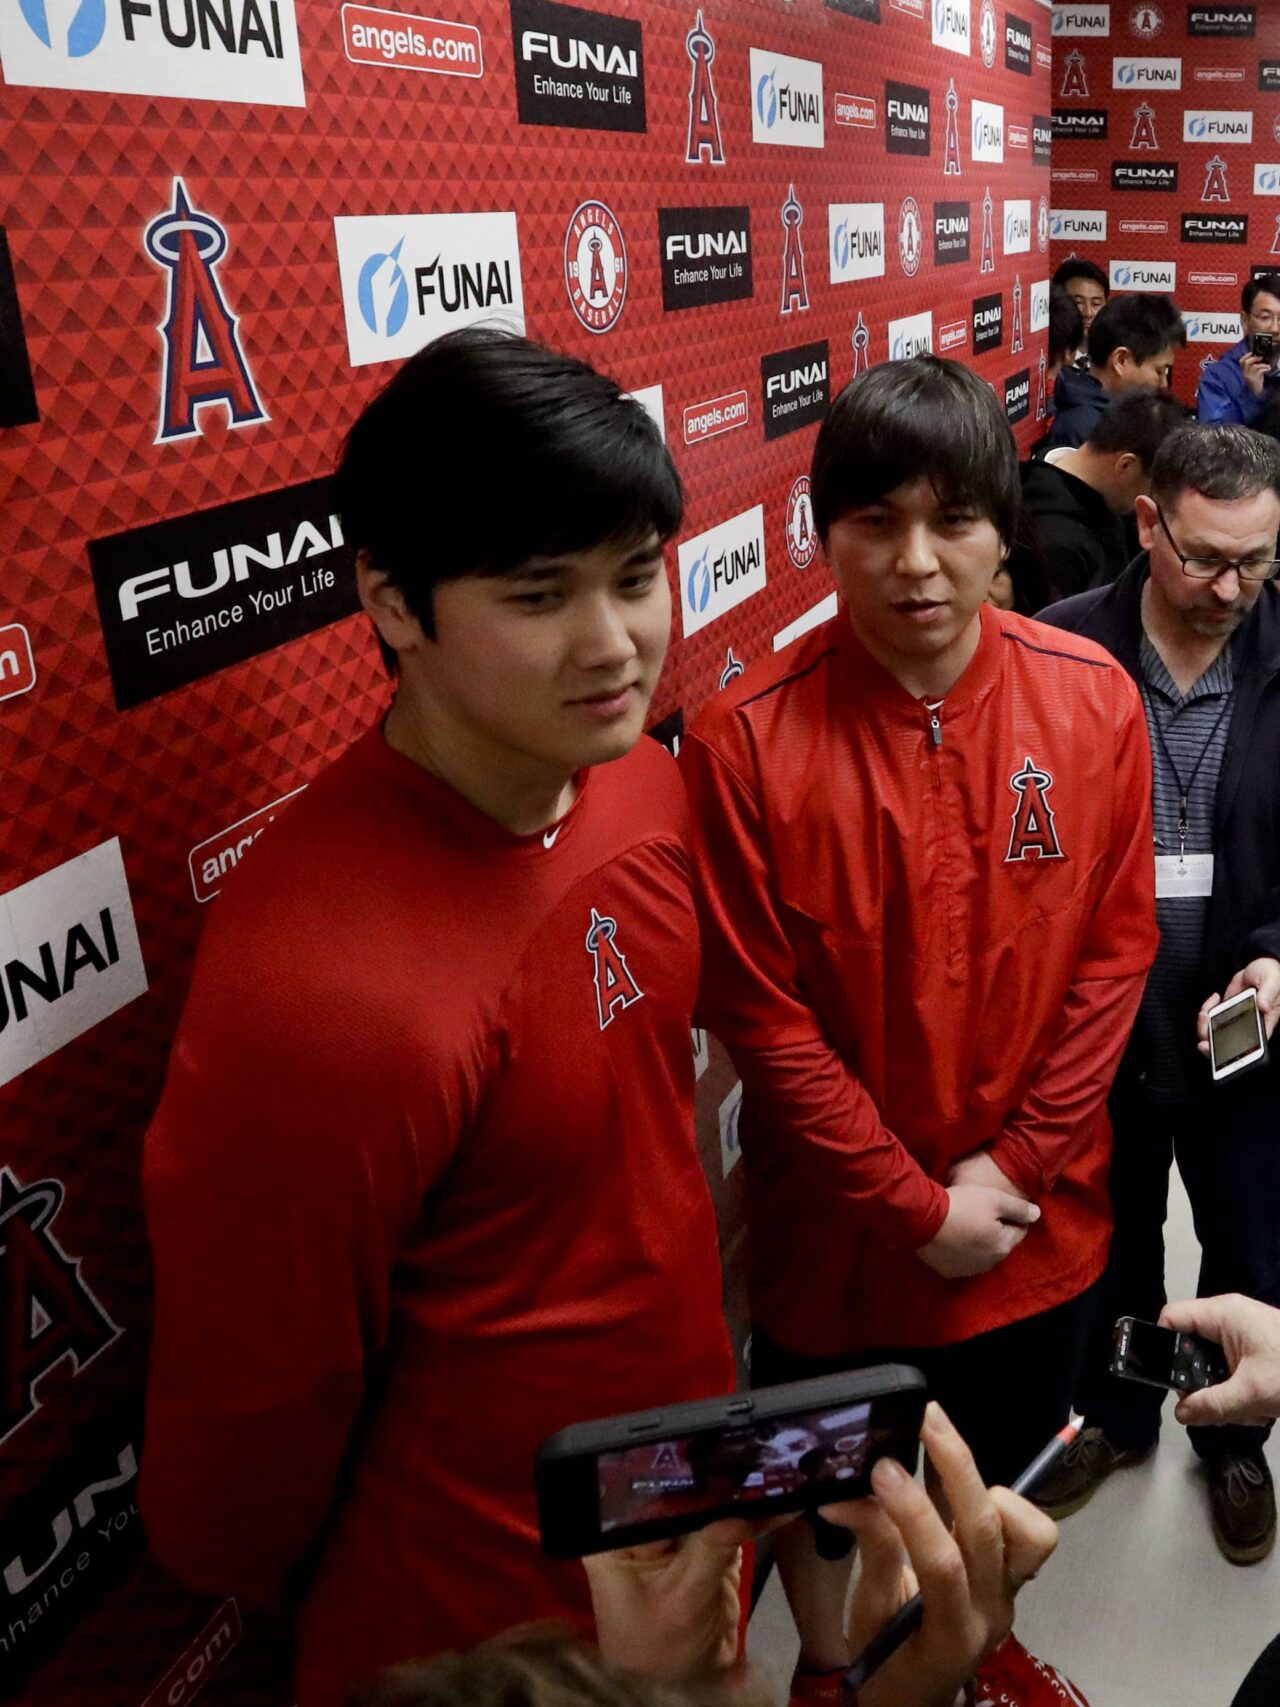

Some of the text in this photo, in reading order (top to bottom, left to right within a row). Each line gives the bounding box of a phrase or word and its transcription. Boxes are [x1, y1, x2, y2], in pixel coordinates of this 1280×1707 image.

[947, 7, 967, 37] FUNAI
[1066, 14, 1106, 28] FUNAI
[1191, 13, 1252, 23] FUNAI
[352, 22, 476, 63] angels.com
[1006, 28, 1031, 50] FUNAI
[522, 31, 638, 77] FUNAI
[1137, 66, 1176, 81] FUNAI
[534, 74, 631, 104] Enhance Your Life
[780, 82, 819, 124] FUNAI
[837, 103, 874, 120] angels.com
[888, 100, 928, 123] FUNAI
[891, 125, 926, 139] Enhance Your Life
[984, 122, 1001, 147] FUNAI
[1208, 120, 1248, 135] FUNAI
[1115, 169, 1174, 178] FUNAI
[573, 208, 615, 237] ANGELS
[936, 216, 969, 235] FUNAI
[1014, 215, 1029, 238] FUNAI
[1064, 219, 1102, 232] FUNAI
[1121, 223, 1166, 231] angels.com
[1185, 220, 1244, 231] FUNAI
[666, 230, 747, 260] FUNAI
[851, 225, 881, 258] FUNAI
[569, 261, 579, 279] 19
[614, 258, 623, 273] 61
[674, 263, 743, 285] Enhance Your Life
[1133, 269, 1171, 284] FUNAI
[416, 253, 514, 315] FUNAI
[573, 287, 623, 325] BASEBALL
[974, 307, 1001, 328] FUNAI
[1201, 321, 1240, 335] FUNAI
[767, 361, 827, 398] FUNAI
[772, 390, 823, 418] Enhance Your Life
[1006, 381, 1029, 404] FUNAI
[687, 402, 745, 434] angels.com
[118, 513, 345, 621] FUNAI
[713, 537, 760, 592] FUNAI
[146, 569, 335, 656] Enhance Your Life
[1004, 757, 1069, 863] A
[0, 908, 121, 1034] NAI
[586, 907, 645, 1031] A
[0, 1549, 90, 1652] nhance
